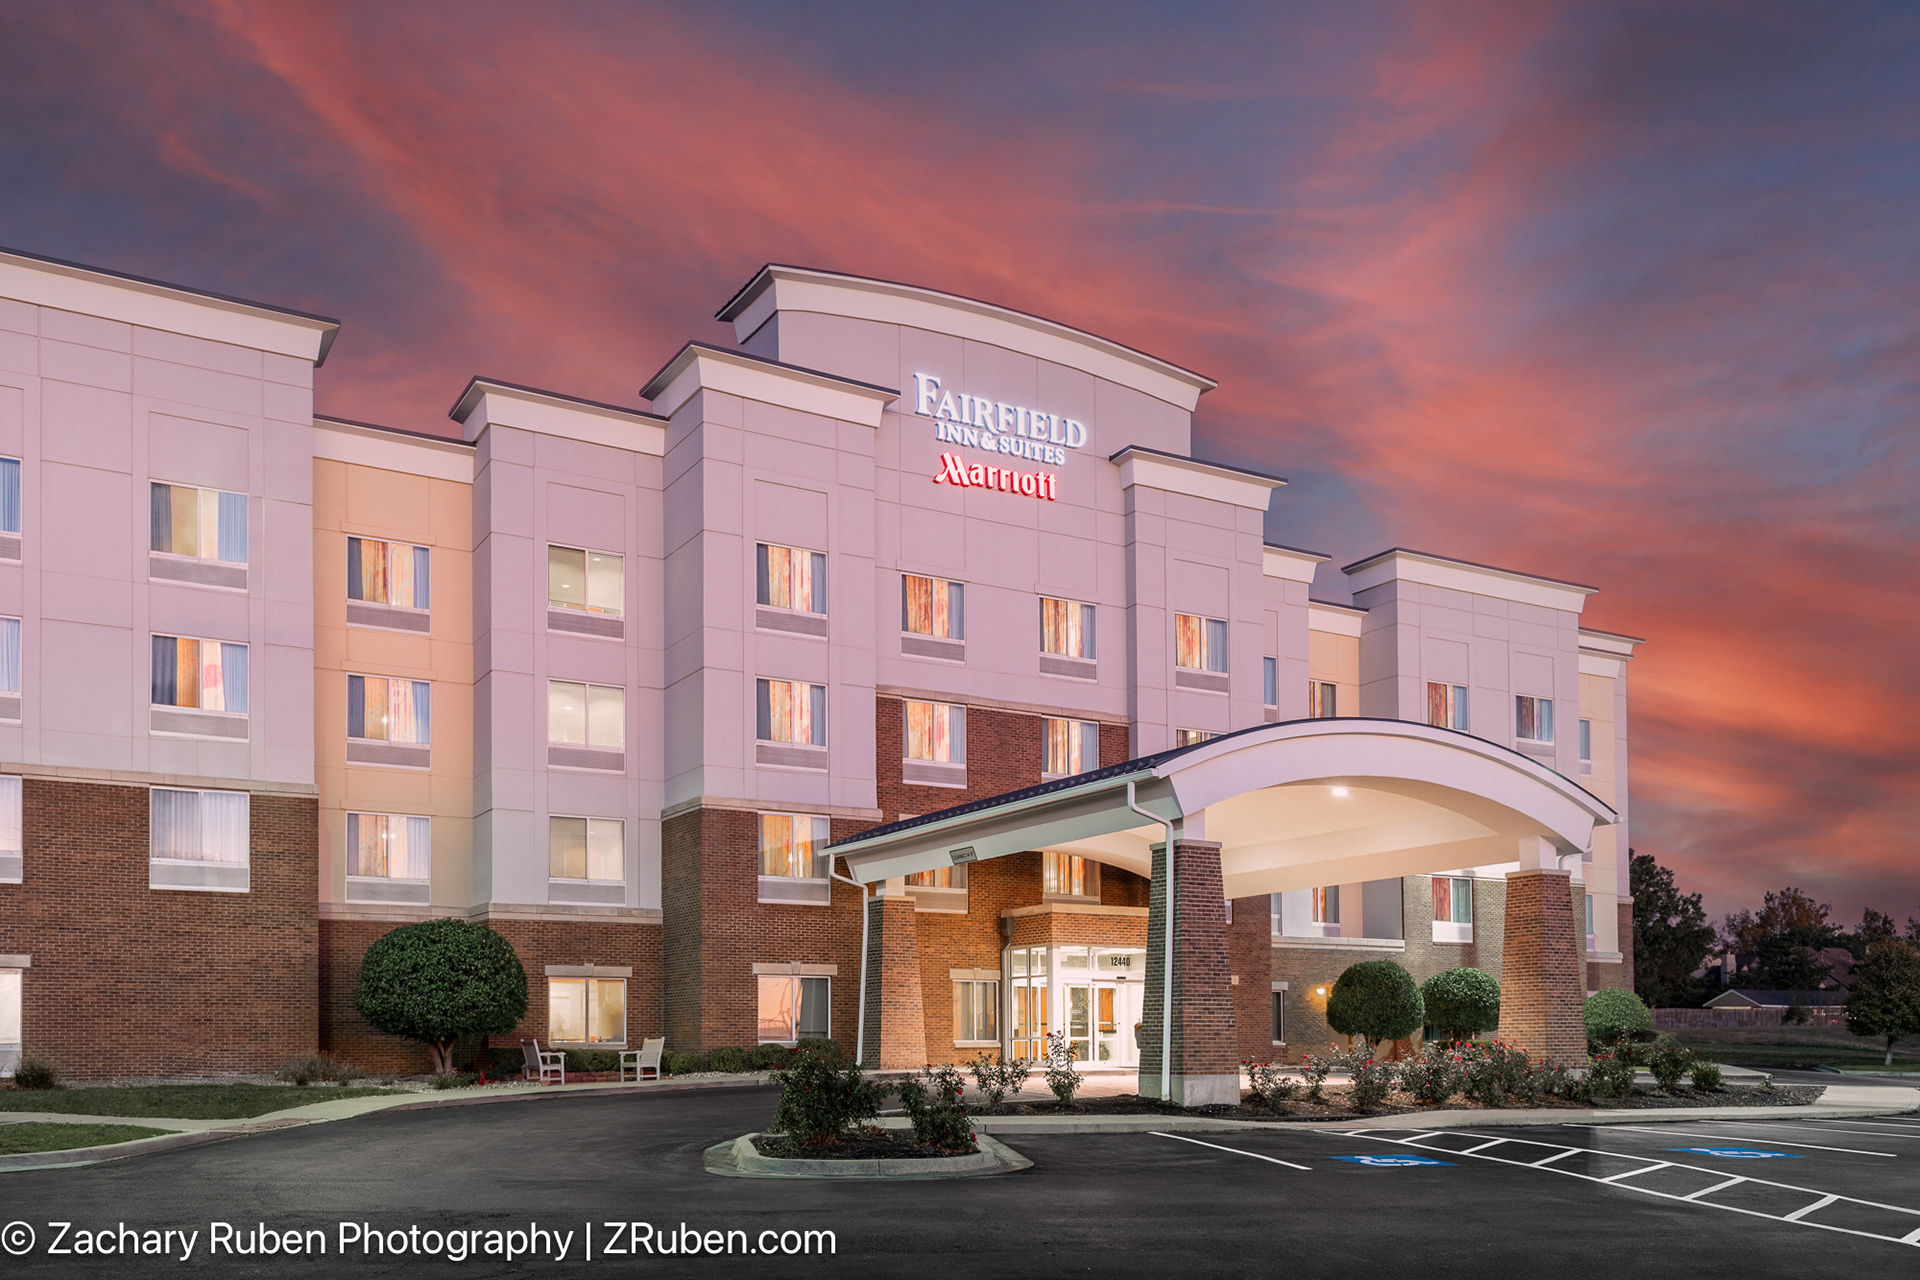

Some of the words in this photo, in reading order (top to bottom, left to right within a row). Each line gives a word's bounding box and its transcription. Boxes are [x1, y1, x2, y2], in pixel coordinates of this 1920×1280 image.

[913, 372, 1087, 449] FAIRFIELD
[935, 422, 979, 449] INN
[979, 432, 998, 451] &
[998, 435, 1066, 466] SUITES
[933, 451, 1057, 501] Marriott
[1110, 956, 1131, 967] 12440
